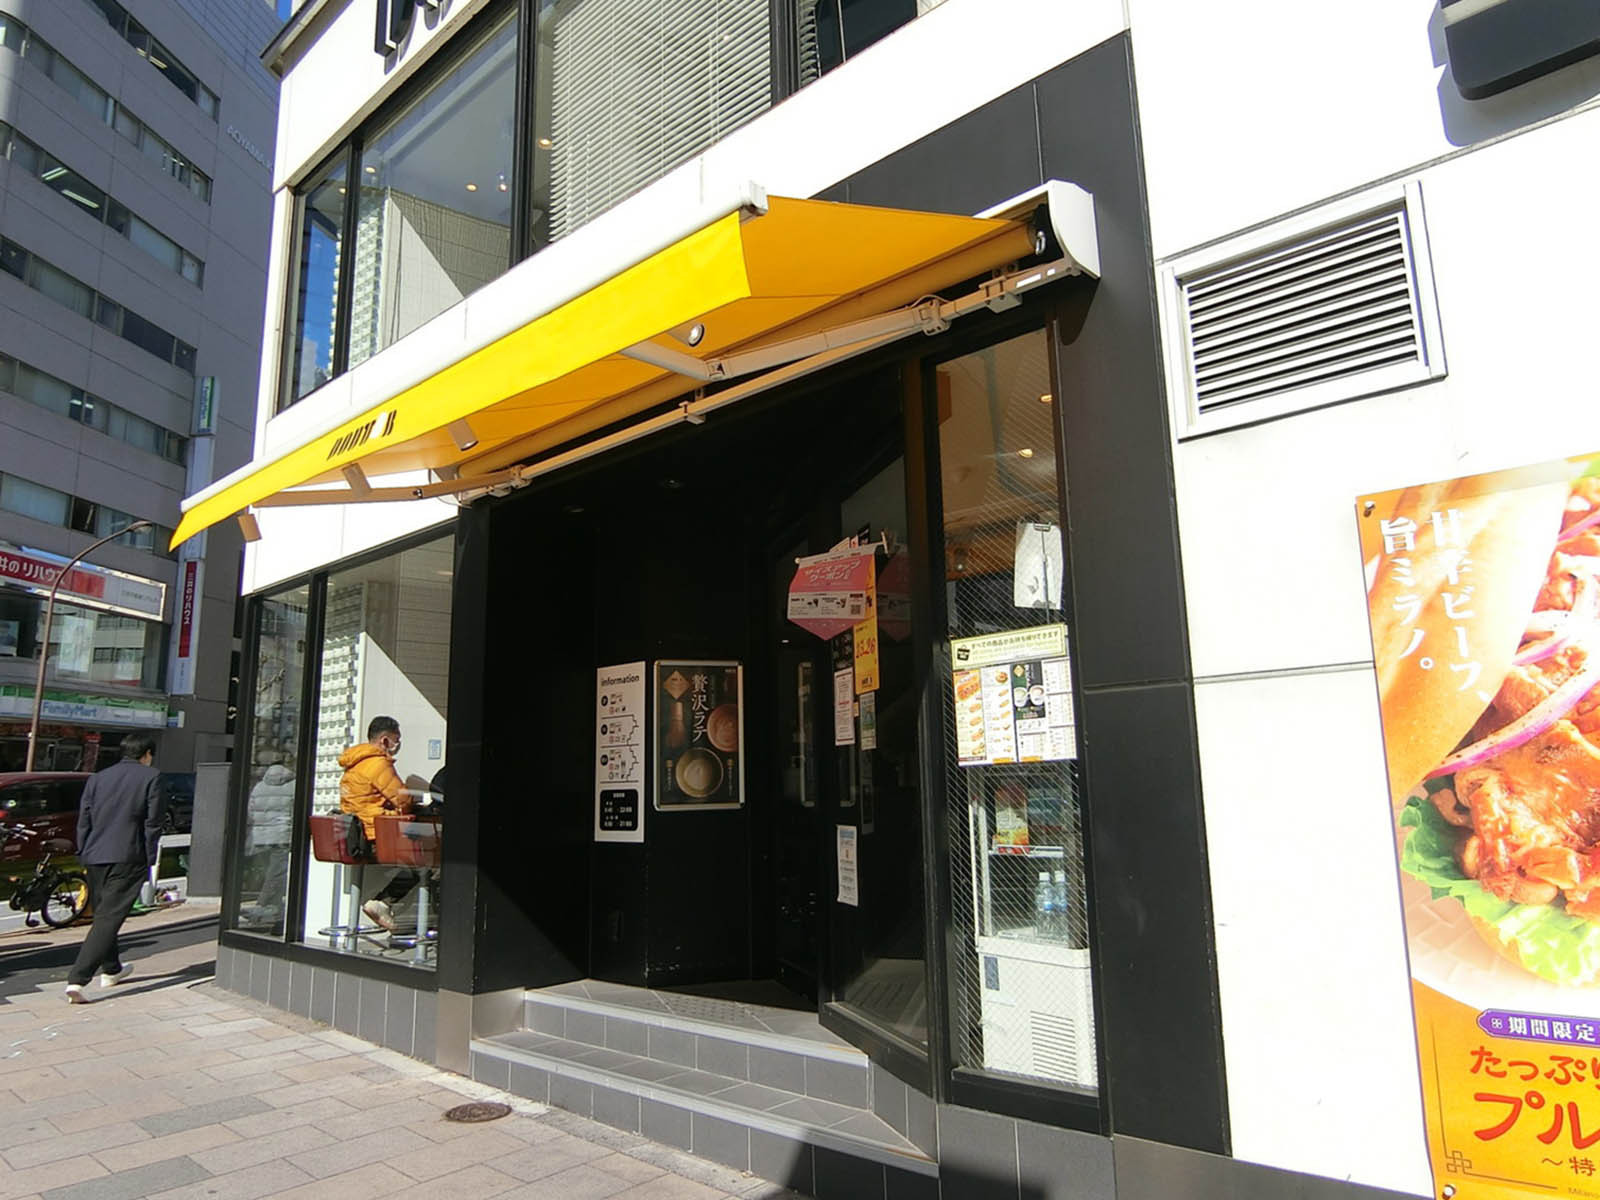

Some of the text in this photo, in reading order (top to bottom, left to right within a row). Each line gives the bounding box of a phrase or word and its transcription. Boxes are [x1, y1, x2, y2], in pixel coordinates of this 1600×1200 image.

[1380, 517, 1435, 671] 旨ミラノ。
[600, 673, 640, 687] information
[42, 701, 98, 718] FamilyMart
[691, 673, 709, 743] 贅沢ラテ
